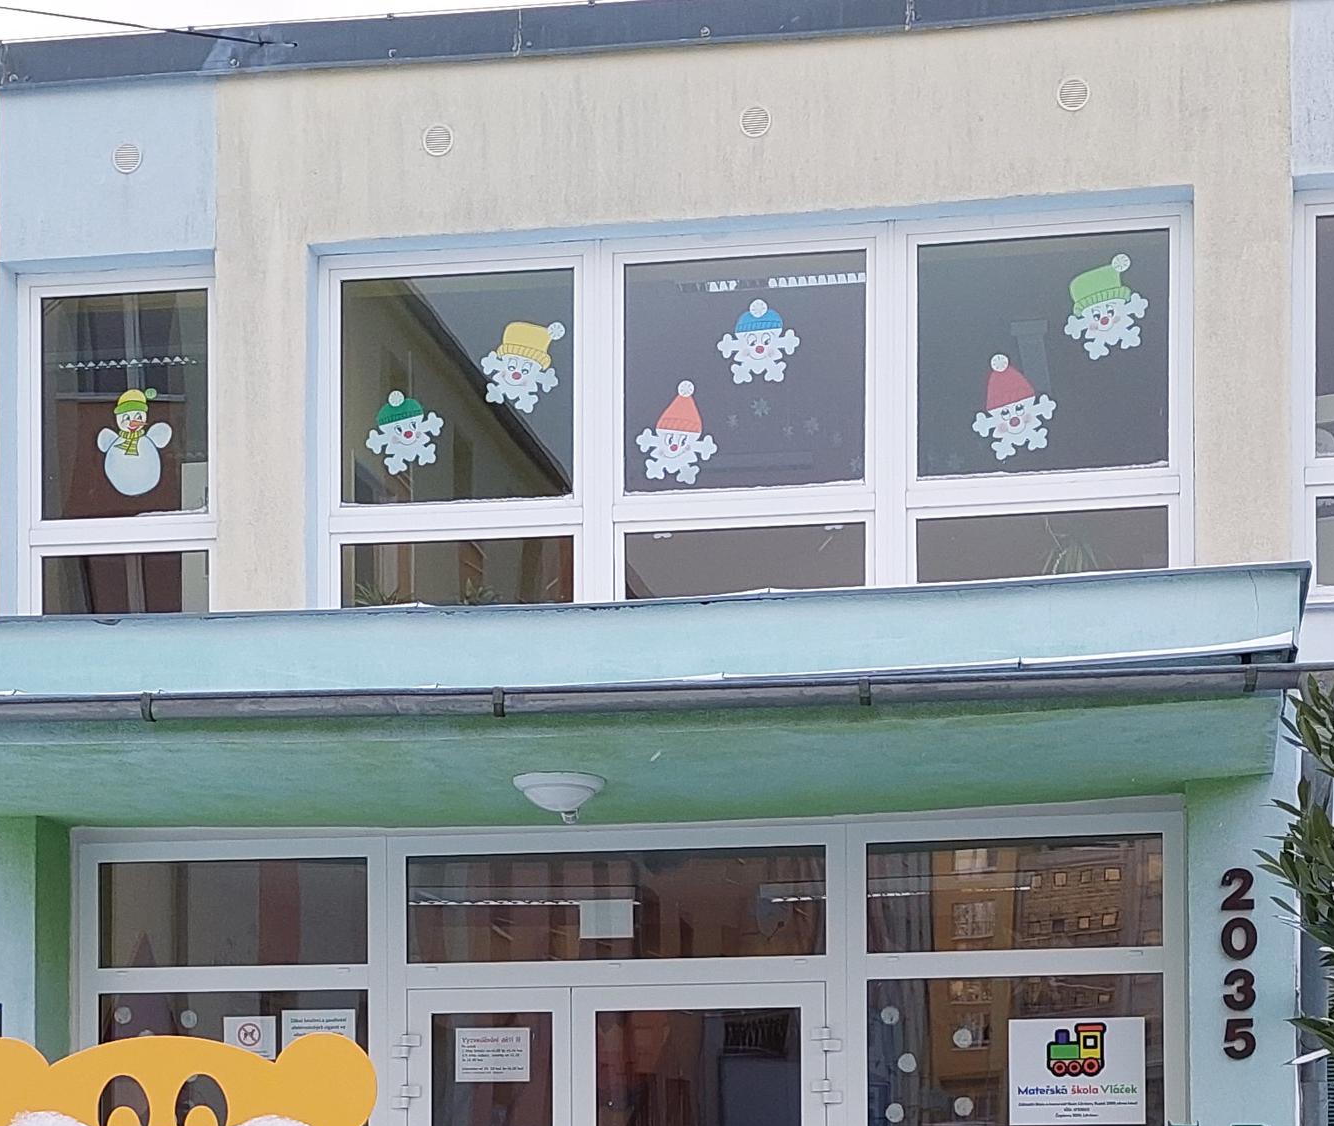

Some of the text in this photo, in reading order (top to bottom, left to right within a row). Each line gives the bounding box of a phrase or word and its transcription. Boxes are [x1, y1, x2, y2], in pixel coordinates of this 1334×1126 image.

[1220, 867, 1258, 1060] 2035
[1018, 1084, 1138, 1095] Mateřská škola Vláček
